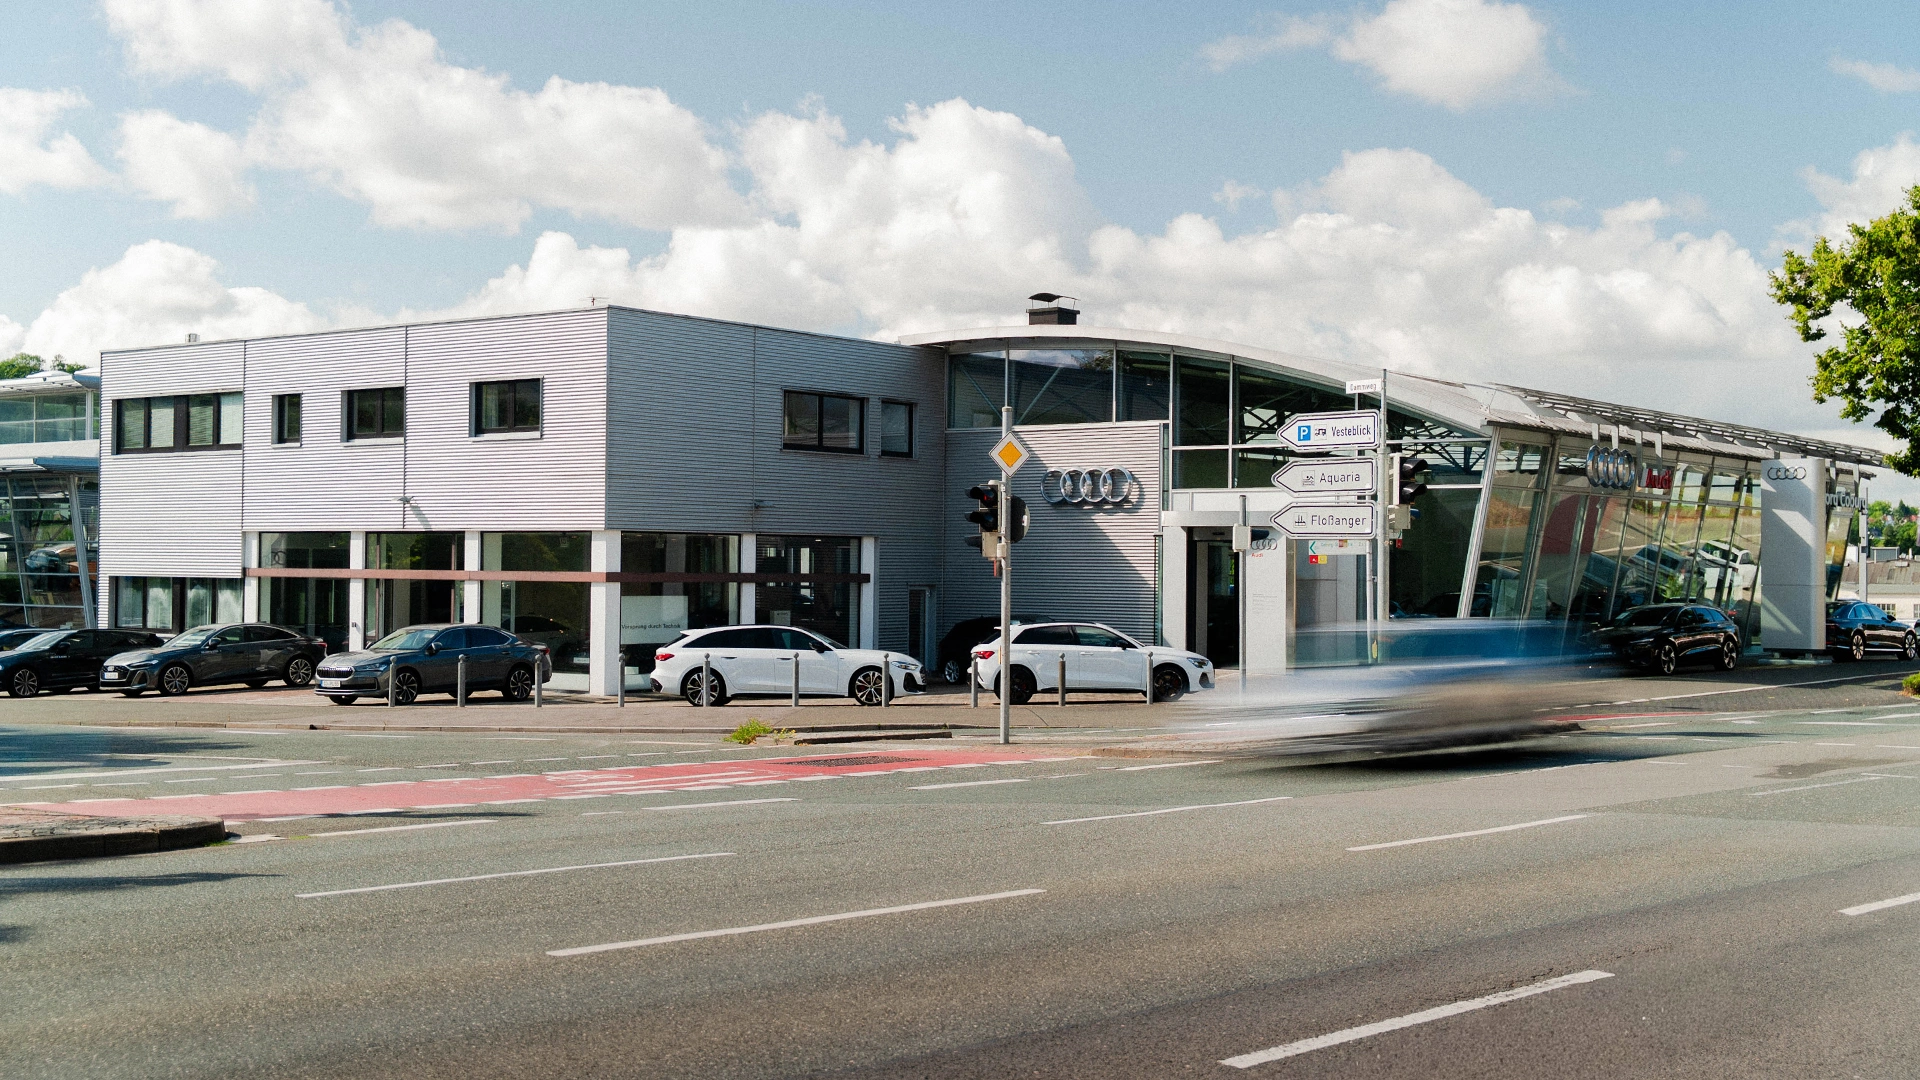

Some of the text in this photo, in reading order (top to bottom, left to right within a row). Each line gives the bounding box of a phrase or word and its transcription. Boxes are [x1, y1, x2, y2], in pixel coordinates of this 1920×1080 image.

[1331, 425, 1371, 437] Vesteblick
[1320, 471, 1361, 485] Aquaria
[1840, 494, 1867, 510] Coburg
[1311, 514, 1367, 528] Floßanger
